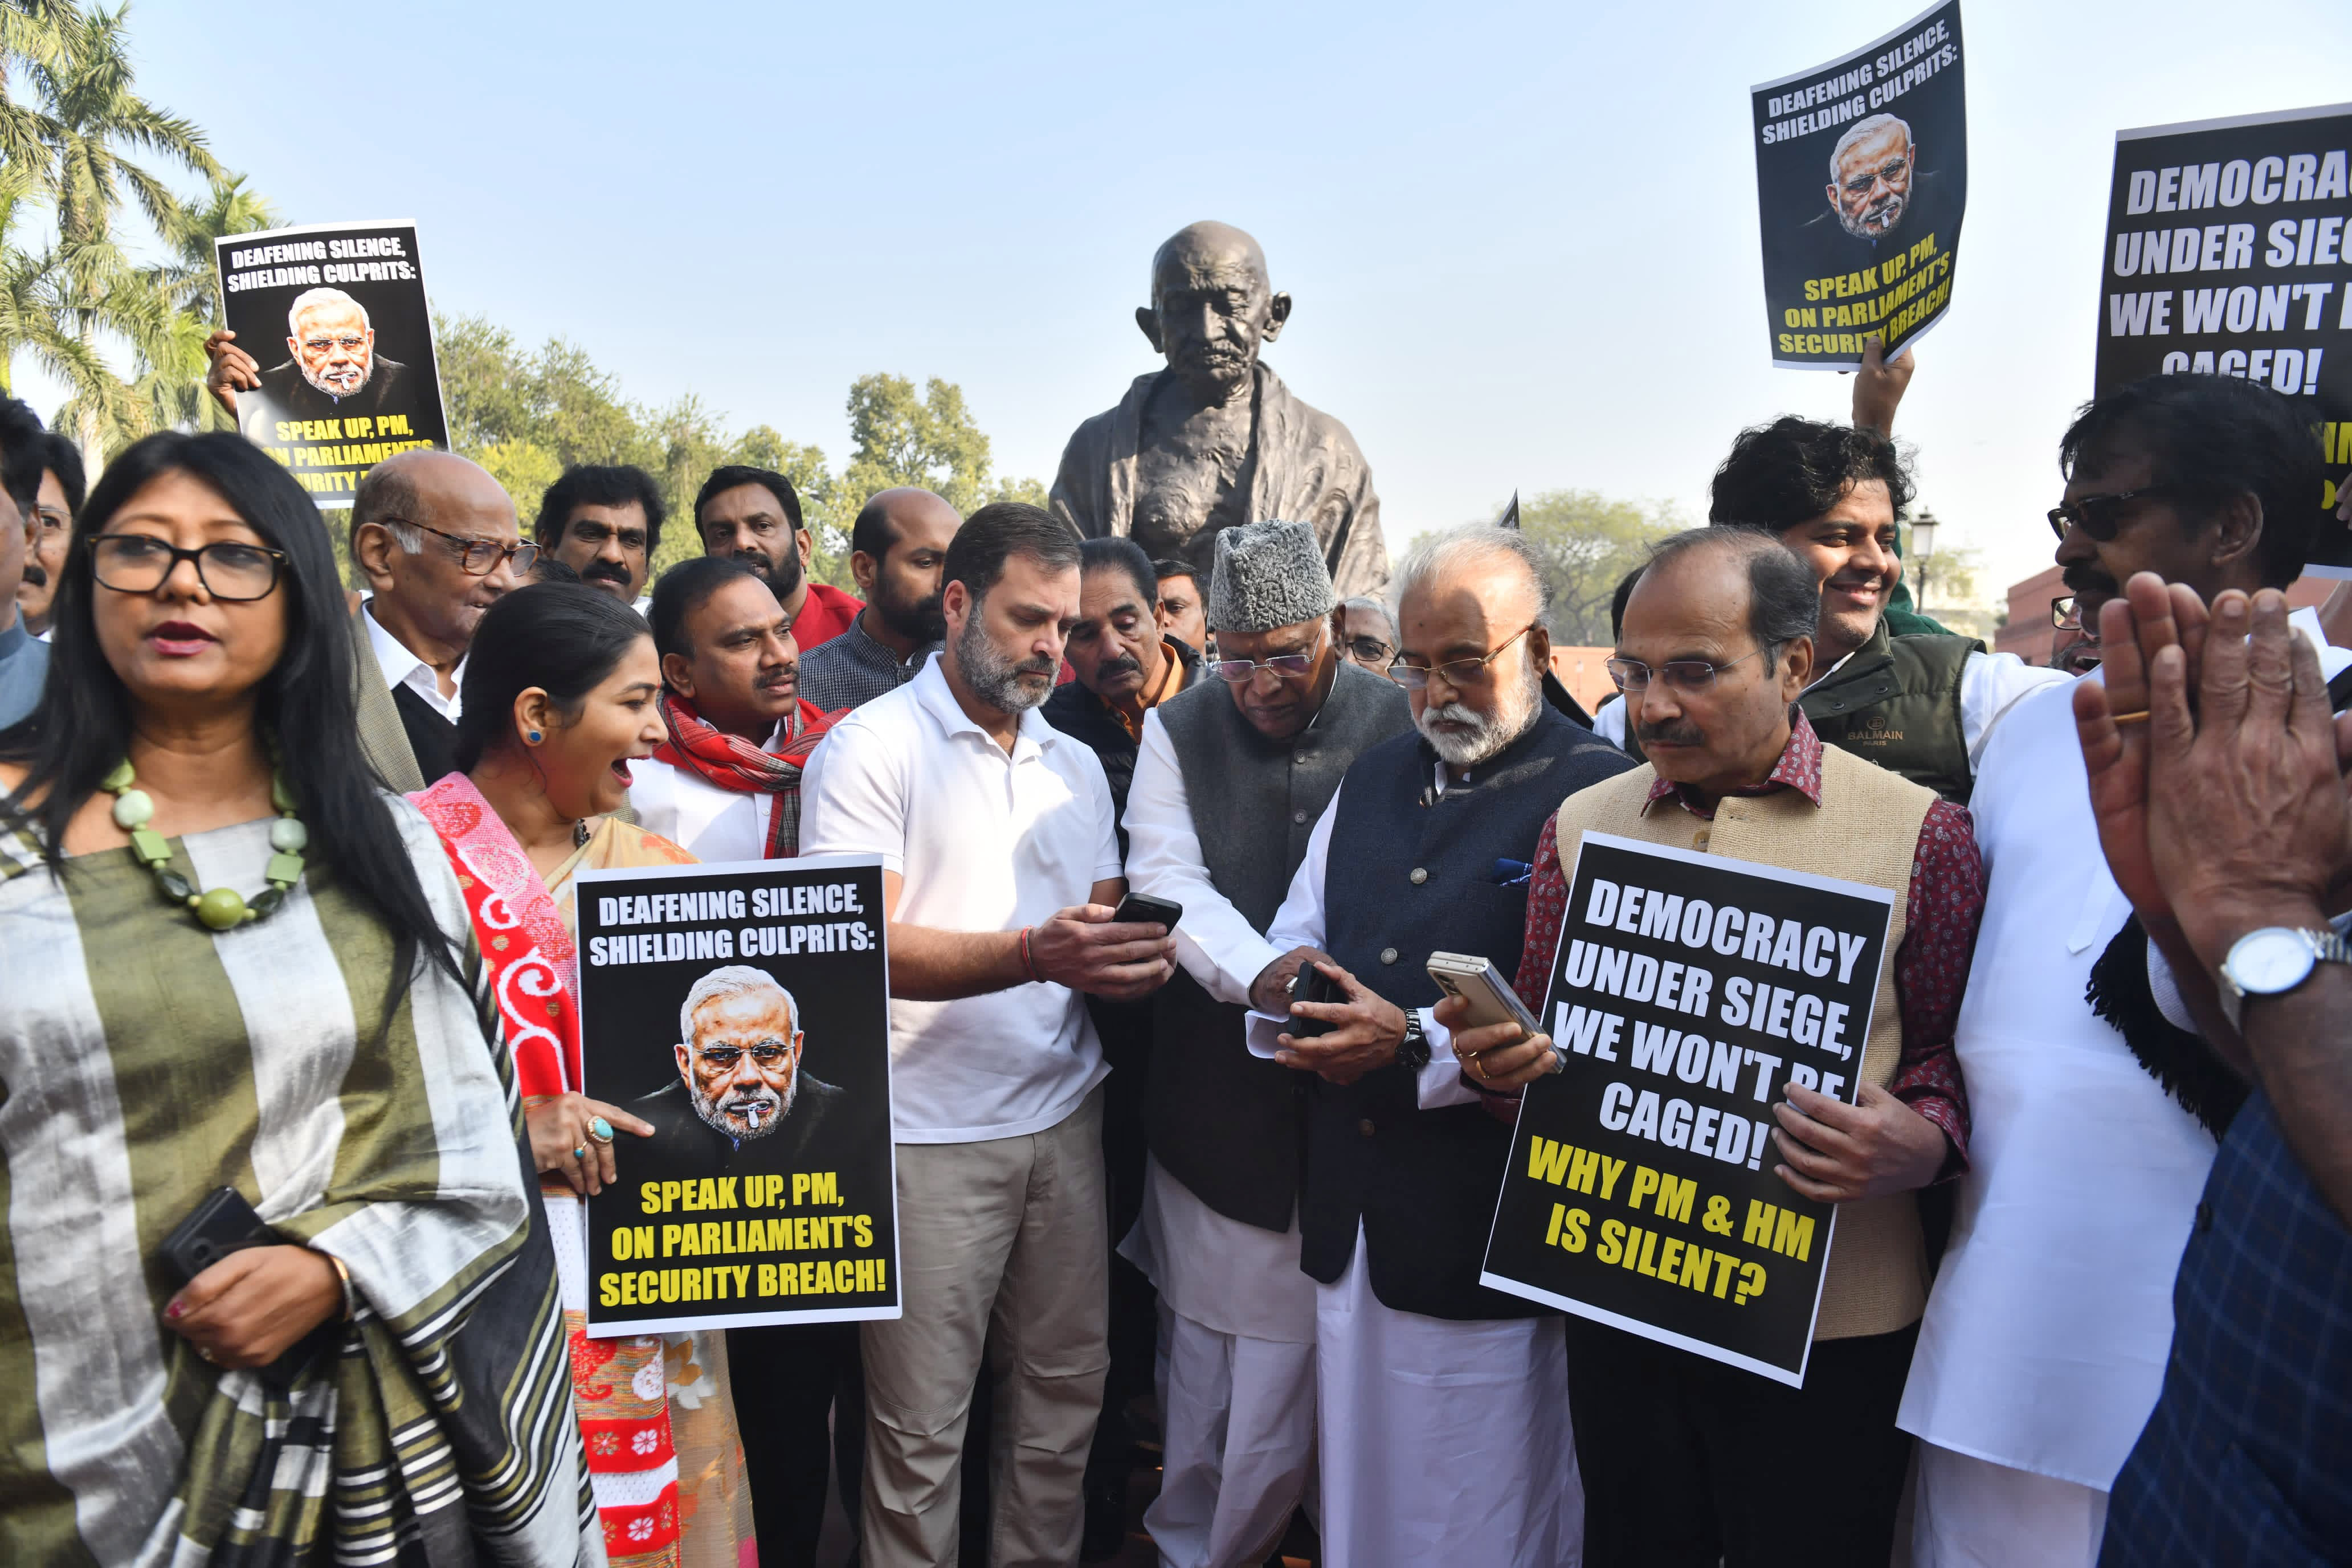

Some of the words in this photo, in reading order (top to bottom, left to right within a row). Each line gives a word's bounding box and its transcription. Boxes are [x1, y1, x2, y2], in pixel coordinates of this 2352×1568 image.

[1762, 95, 1865, 144] SHIELDING
[1869, 43, 1957, 109] CULPRITS:
[1769, 64, 1872, 118] DEAFENING
[1876, 19, 1949, 77] SILENCE,
[2126, 150, 2352, 215] DEMOCRA
[228, 266, 321, 292] SHIELDING
[322, 261, 416, 283] CULPRITS:
[231, 241, 327, 269] DEAFENING
[329, 237, 406, 259] SILENCE,
[1804, 266, 1879, 301] SPEAK
[1882, 253, 1906, 284] UP,
[1910, 232, 1937, 270] PM,
[2114, 223, 2255, 276] UNDER
[1785, 308, 1817, 328] ON
[1822, 251, 1950, 328] PARLIAMENT'S
[1890, 276, 1951, 342] BREACH!
[2110, 291, 2172, 337] WE
[2183, 283, 2333, 334] WON'T
[275, 419, 343, 442] SPEAK
[344, 418, 374, 439] UP,
[377, 415, 414, 436] PM,
[1848, 730, 1903, 740] BALMAIN
[599, 890, 745, 926] DEAFENING
[752, 884, 864, 917] SILENCE,
[1585, 879, 1867, 984] DEMOCRACY
[590, 930, 733, 966] SHIELDING
[740, 922, 875, 957] CULPRITS:
[1565, 939, 1713, 1017] UNDER
[1721, 977, 1852, 1061] SIEGE,
[1553, 1001, 1627, 1062] WE
[1630, 1020, 1782, 1103] WON'T
[1600, 1083, 1769, 1171] CAGED!
[641, 1177, 738, 1214] SPEAK
[745, 1174, 786, 1209] UP,
[792, 1171, 844, 1207] PM,
[1528, 1136, 1628, 1200] WHY
[1628, 1165, 1698, 1223] PM
[1702, 1195, 1734, 1237] &
[1742, 1199, 1815, 1262] HM
[612, 1226, 654, 1260] ON
[662, 1214, 873, 1257] PARLIAMENT'S
[1545, 1203, 1591, 1253] IS
[1596, 1219, 1767, 1306] SILENT?
[600, 1265, 751, 1306] SECURITY
[758, 1259, 886, 1297] BREACH!
